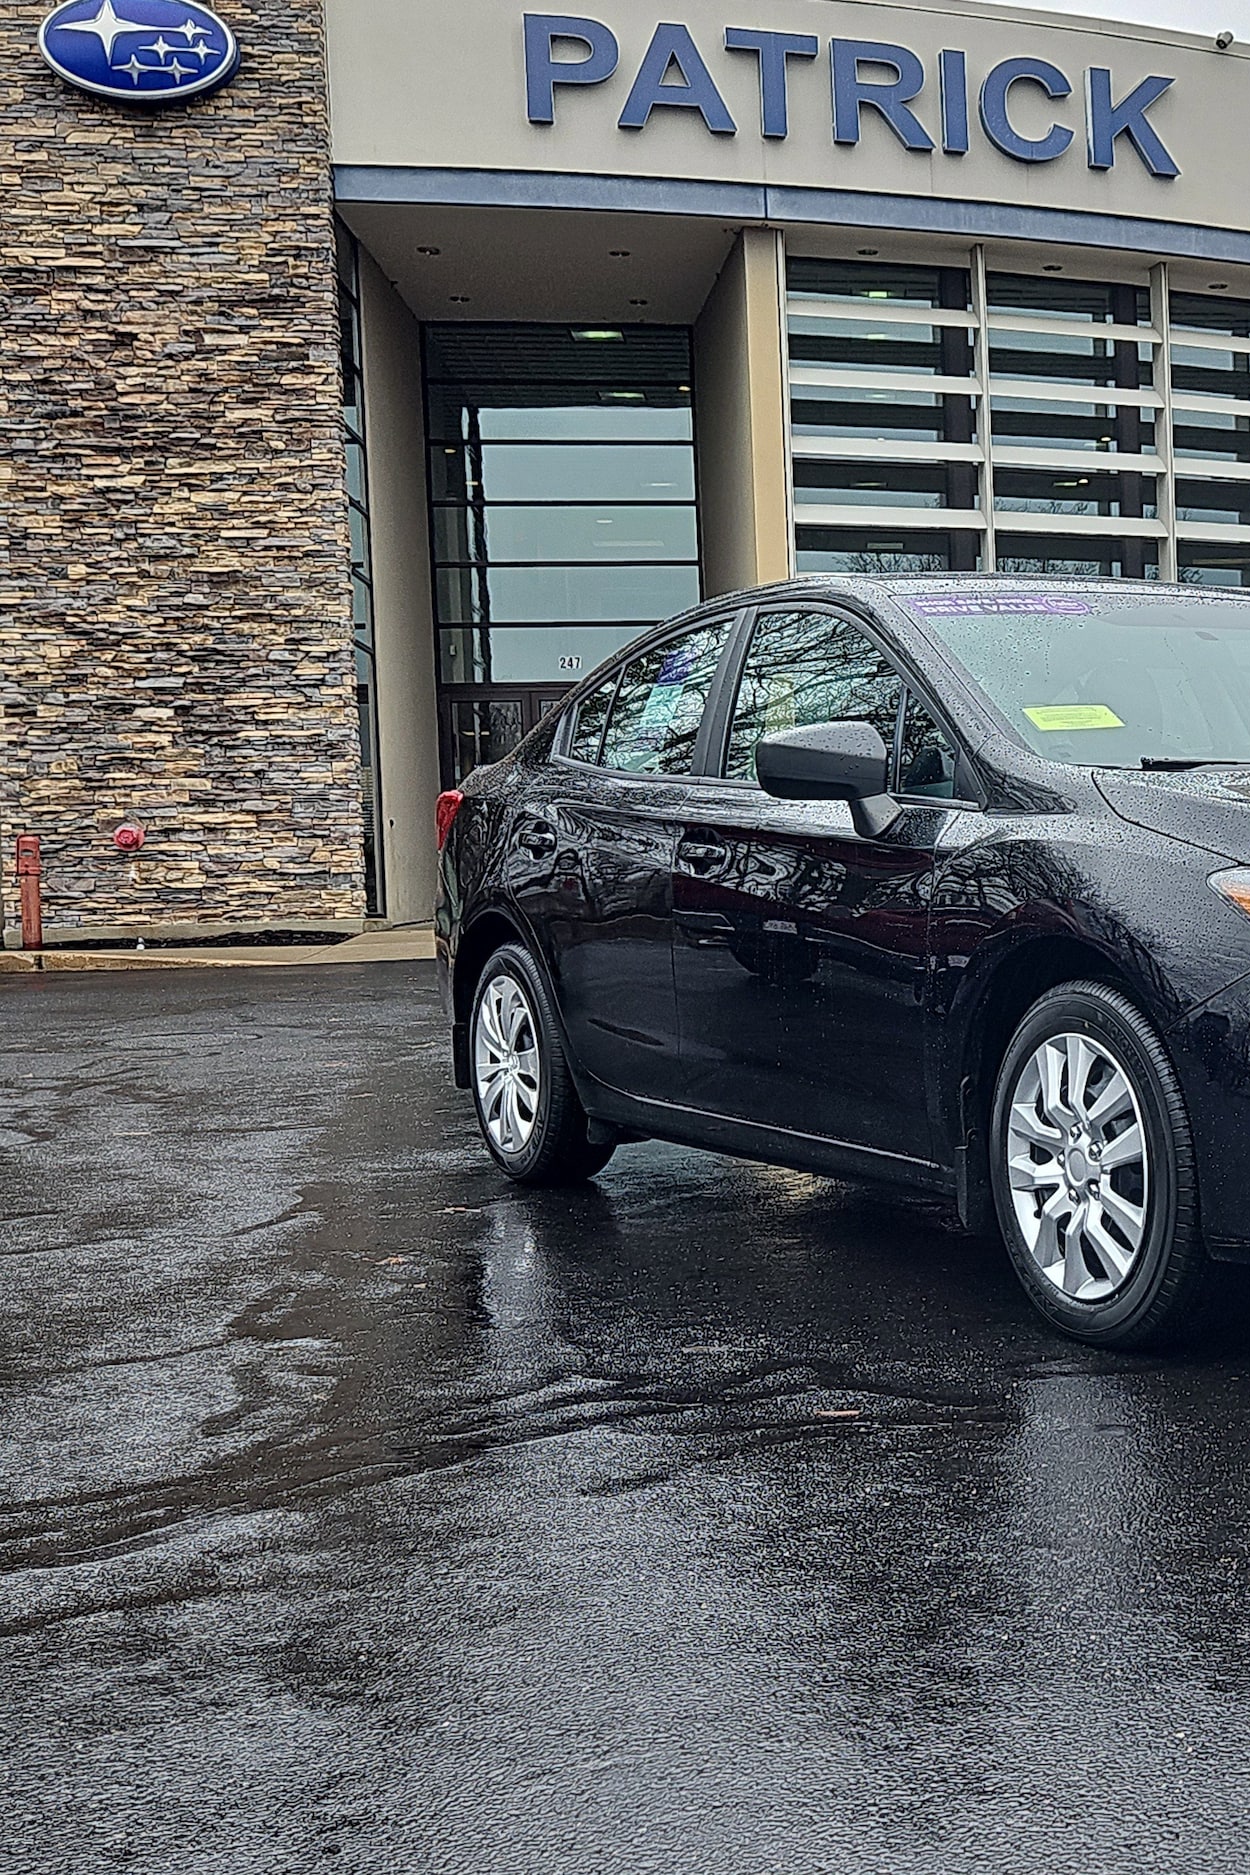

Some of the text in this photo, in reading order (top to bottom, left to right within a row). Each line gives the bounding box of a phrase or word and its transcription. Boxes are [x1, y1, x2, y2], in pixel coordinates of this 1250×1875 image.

[522, 13, 1182, 179] PATRICK
[922, 605, 984, 613] DRIVE
[984, 604, 1049, 612] VALUE
[559, 656, 581, 669] 247
